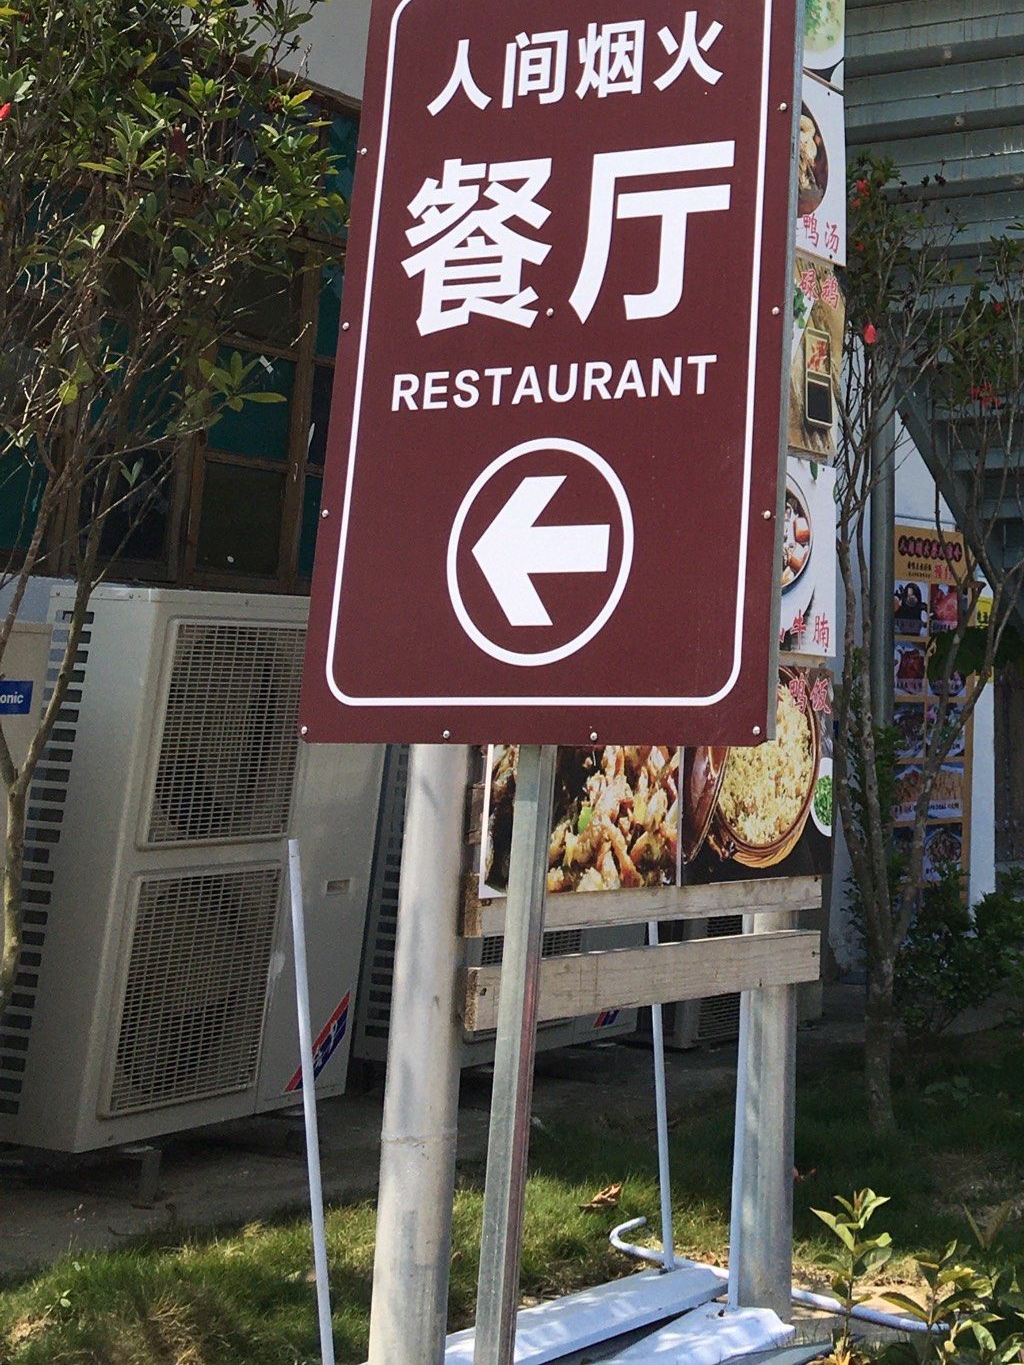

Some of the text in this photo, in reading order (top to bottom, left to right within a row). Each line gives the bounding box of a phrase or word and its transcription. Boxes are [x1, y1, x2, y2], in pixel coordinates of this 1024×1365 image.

[427, 10, 724, 117] 人间烟火
[400, 140, 736, 337] 餐厅
[797, 213, 840, 254] 鸭汤
[391, 354, 718, 412] RESTAURANT
[777, 675, 831, 714] 鸭饭
